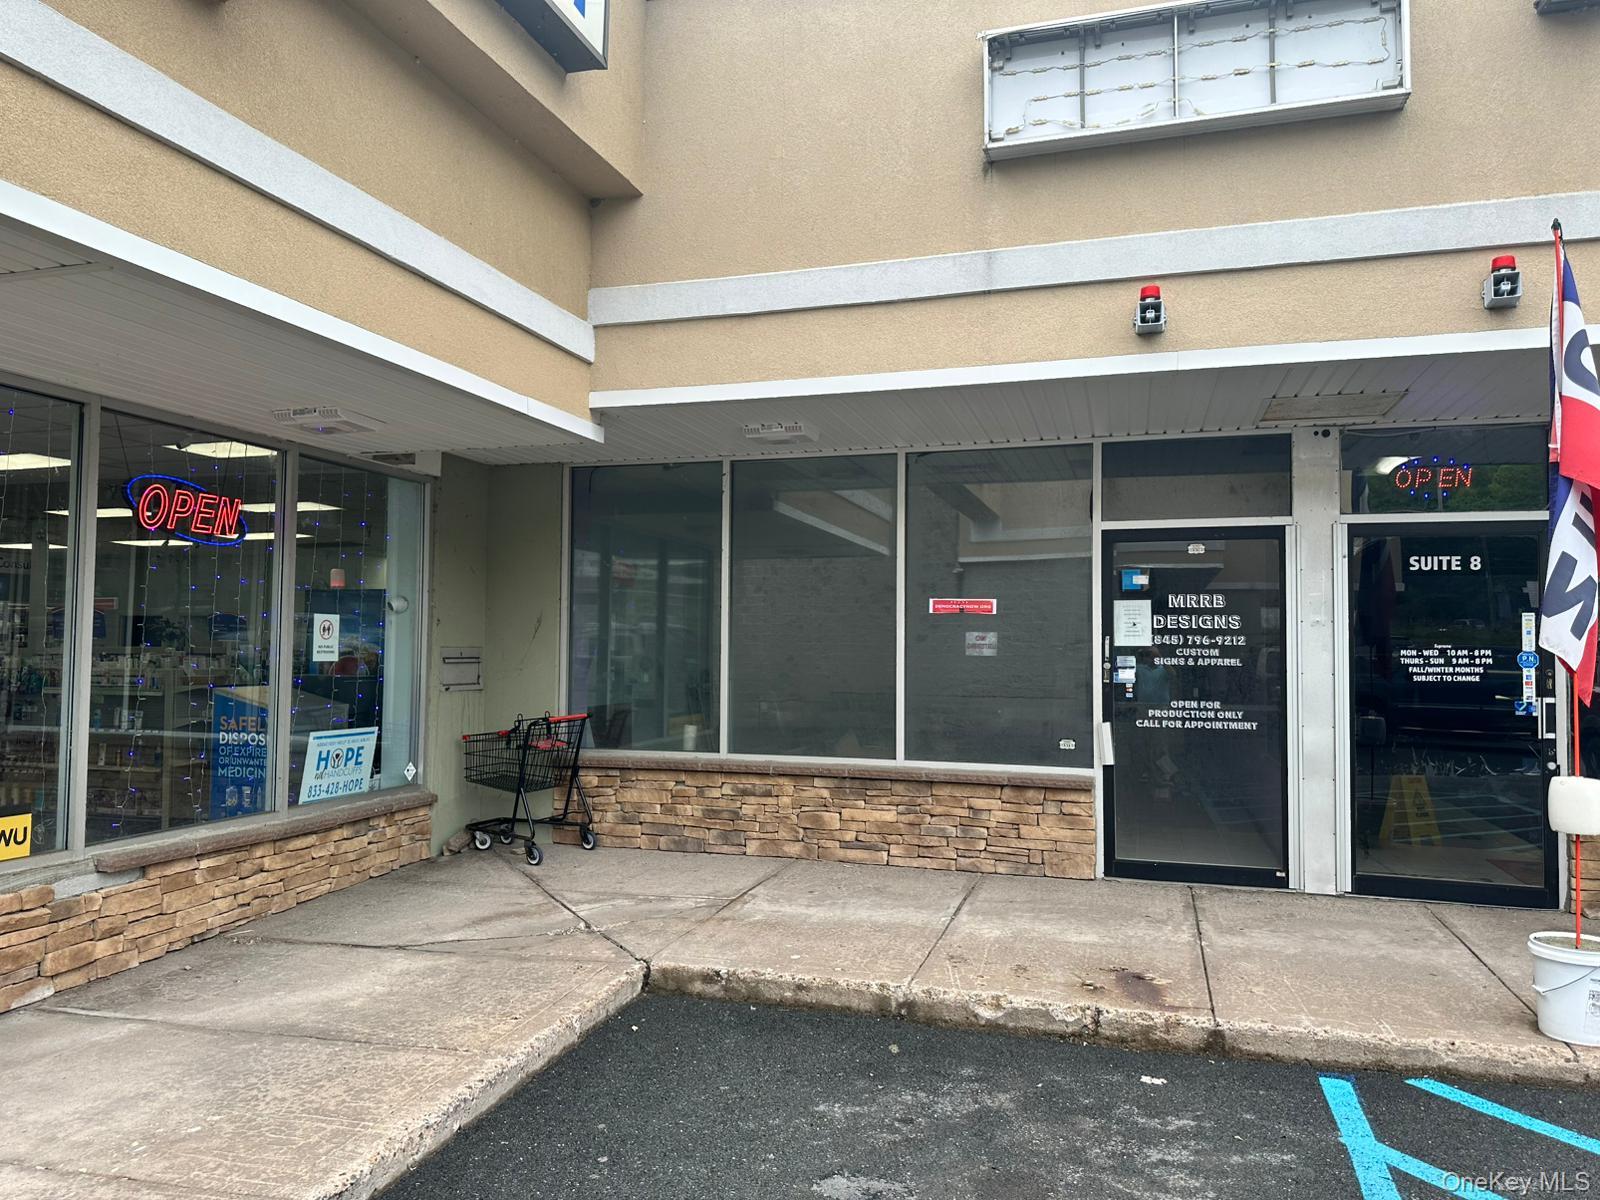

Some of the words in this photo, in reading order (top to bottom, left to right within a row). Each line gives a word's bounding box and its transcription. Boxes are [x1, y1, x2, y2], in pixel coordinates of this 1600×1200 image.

[1395, 467, 1473, 489] OPEN
[138, 483, 242, 536] OPEN
[1409, 555, 1462, 571] SUITE
[1469, 555, 1482, 571] 8
[1168, 593, 1227, 608] MRRB
[1153, 614, 1243, 629] DESIGNS
[1186, 635, 1247, 646] 796-9212
[1176, 647, 1220, 657] CUSTOM
[1400, 649, 1417, 657] MON
[1422, 649, 1439, 657] WED
[1446, 649, 1456, 657] 10
[1457, 649, 1469, 657] AM
[1474, 649, 1480, 657] 8
[1480, 649, 1492, 657] PM
[1154, 657, 1185, 666] SIGNS
[1187, 657, 1195, 666] &
[1197, 658, 1244, 667] APPAREL
[1400, 657, 1424, 665] THURS
[1429, 657, 1445, 665] SUN
[1451, 657, 1457, 665] 9
[1457, 657, 1470, 665] AM
[1475, 657, 1481, 665] 8
[1481, 657, 1493, 665] PM
[1408, 666, 1454, 674] FALL/WINTER
[1454, 666, 1484, 674] MONTHS
[1170, 700, 1199, 709] OPEN
[1200, 701, 1221, 709] FOR
[1148, 709, 1215, 719] PRODUCTION
[1217, 710, 1244, 719] ONLY
[1136, 719, 1160, 728] CALL
[1162, 720, 1183, 729] FOR
[1184, 720, 1258, 730] APPOINTMENT
[219, 731, 266, 746] DISPOS
[218, 746, 231, 756] OF
[233, 746, 267, 758] EXPIRE
[218, 756, 230, 765] OR
[231, 757, 267, 767] UNWANTE
[316, 746, 364, 771] HOPE
[217, 766, 266, 779] MEDICIN
[308, 777, 363, 799] 833-428-HOPE
